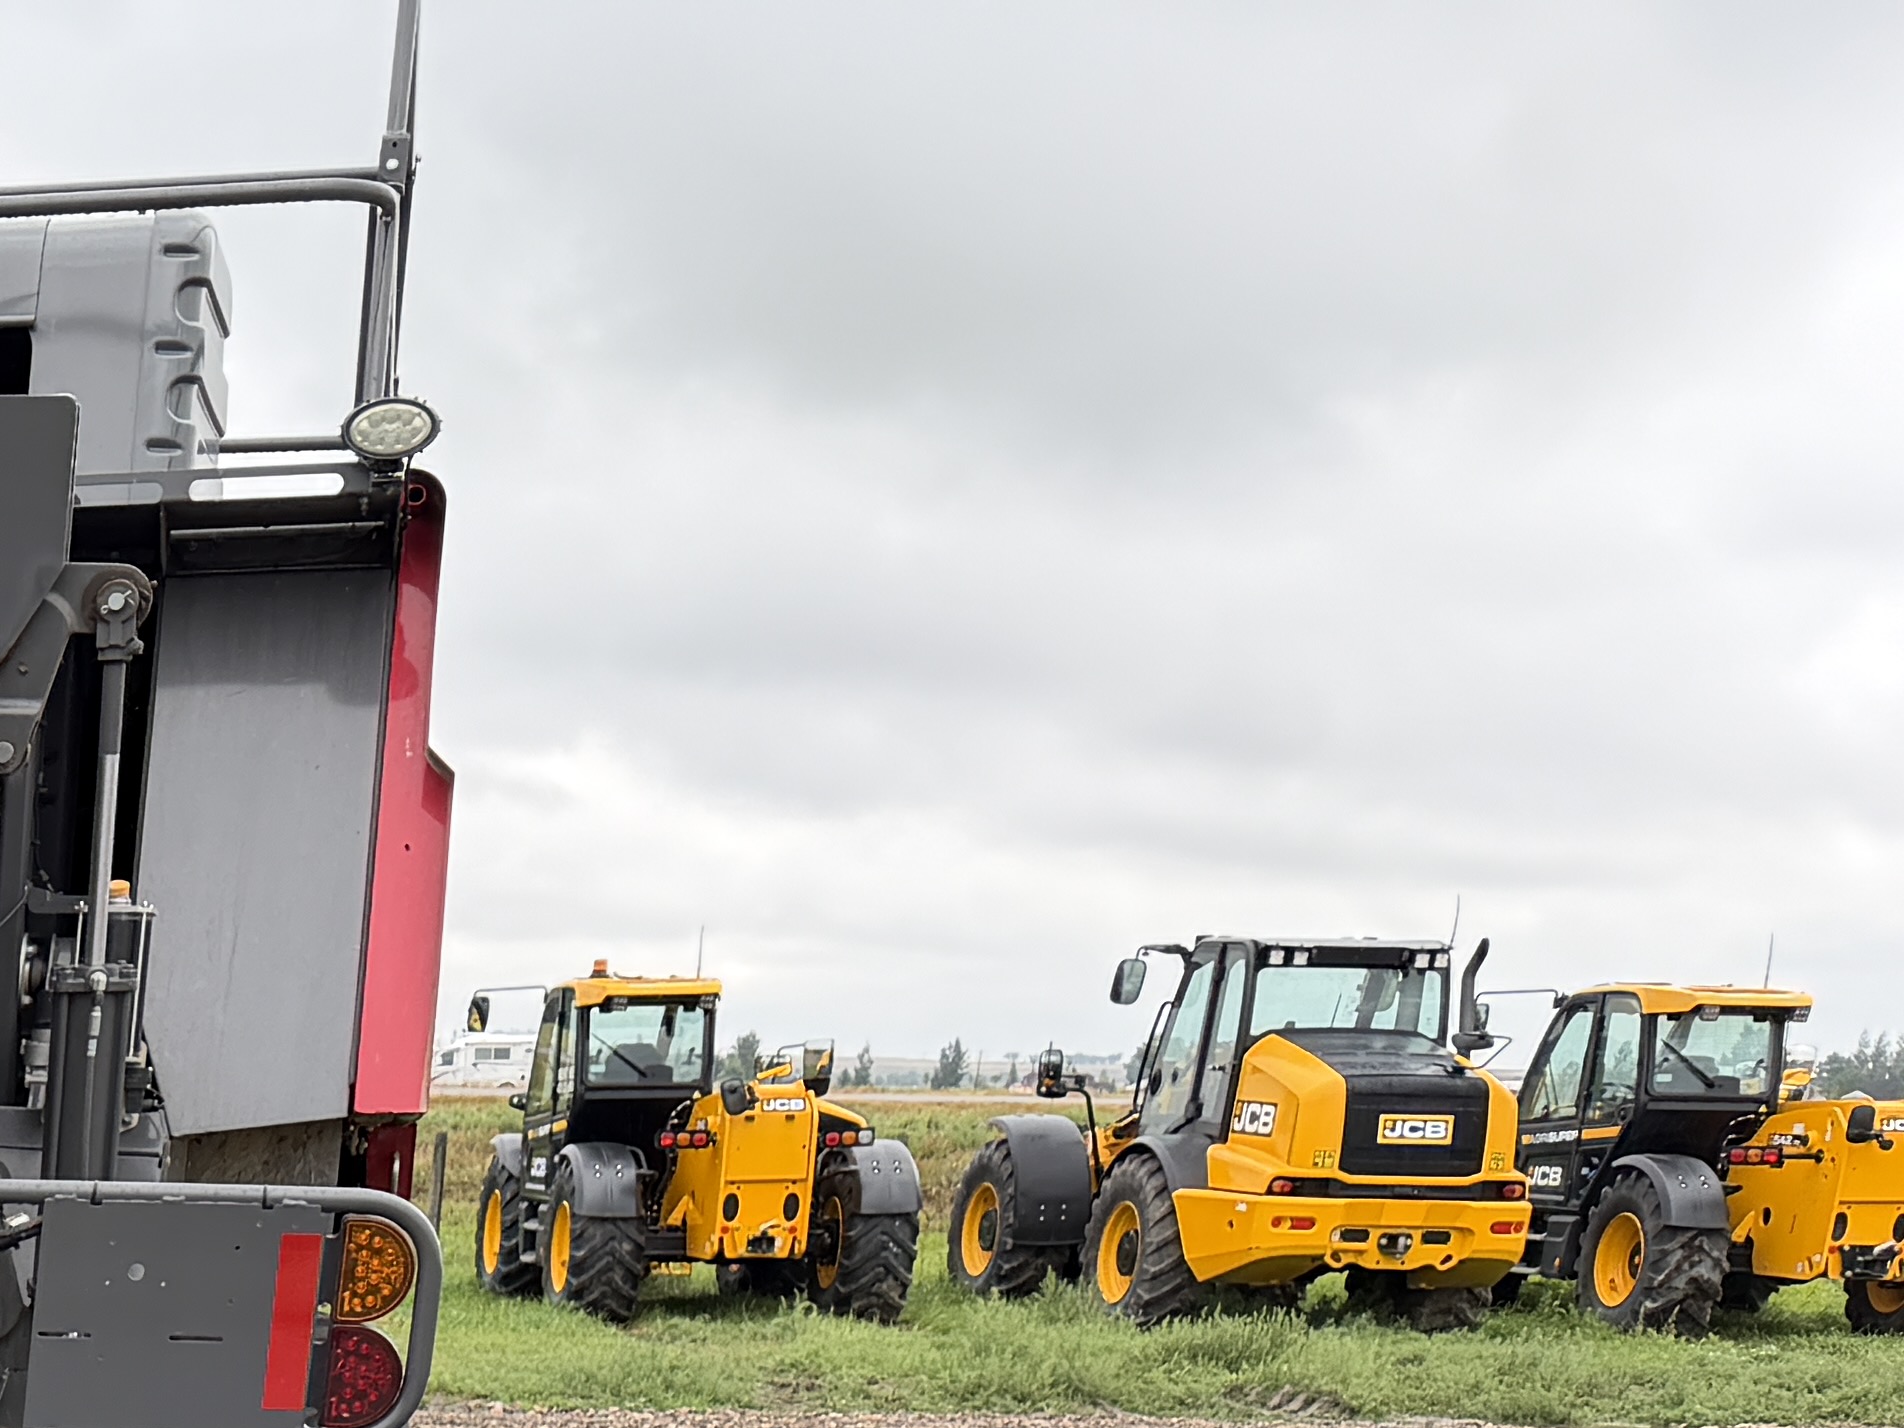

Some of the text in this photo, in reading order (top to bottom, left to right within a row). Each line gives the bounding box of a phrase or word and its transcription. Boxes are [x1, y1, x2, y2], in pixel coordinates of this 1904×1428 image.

[762, 1098, 805, 1111] JCB
[1232, 1101, 1277, 1135] JCB
[1881, 1118, 1904, 1131] JC
[1383, 1120, 1449, 1139] JCB
[1527, 1165, 1563, 1186] JCB
